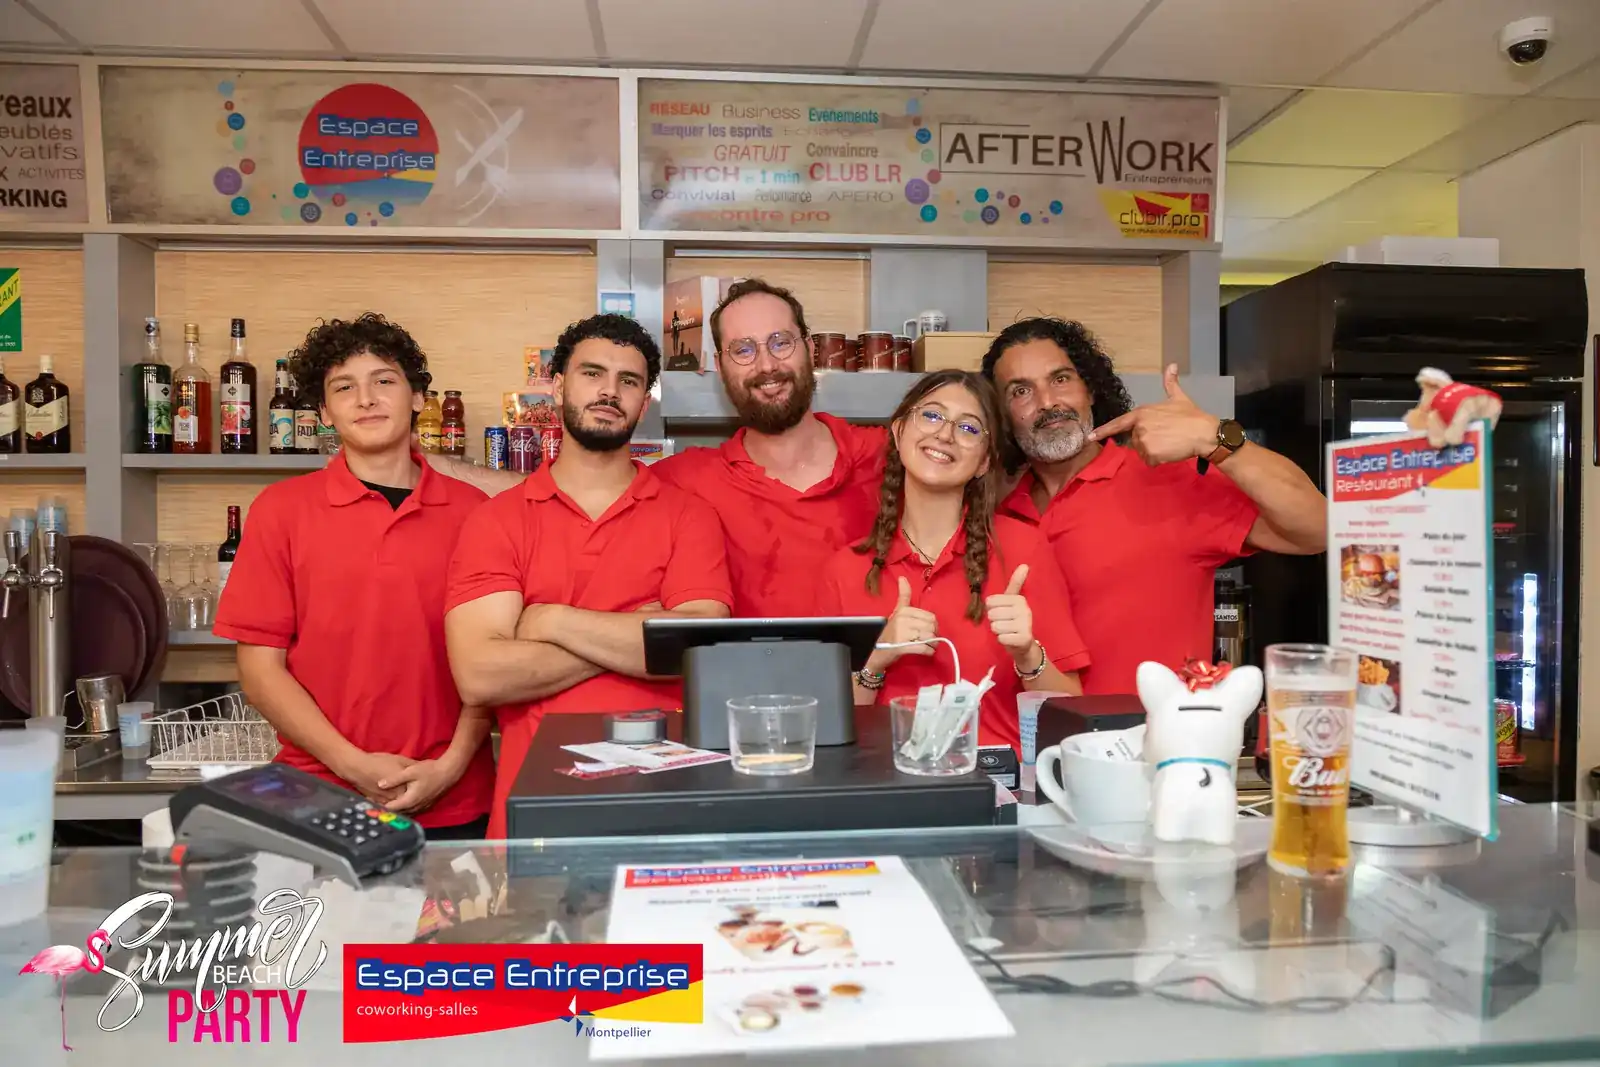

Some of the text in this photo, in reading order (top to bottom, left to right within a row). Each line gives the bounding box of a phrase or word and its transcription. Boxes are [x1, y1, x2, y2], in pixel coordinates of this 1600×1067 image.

[722, 104, 801, 119] Business
[319, 117, 418, 137] Espace
[304, 150, 434, 170] Entreprise
[714, 142, 879, 162] GRATUIT Convaincre
[663, 165, 740, 182] PITCH
[808, 162, 868, 182] CLUB
[875, 164, 901, 183] LR
[651, 189, 735, 201] Convivial
[790, 209, 830, 224] pro
[1335, 454, 1388, 476] Espace
[1335, 474, 1413, 493] Restaurant
